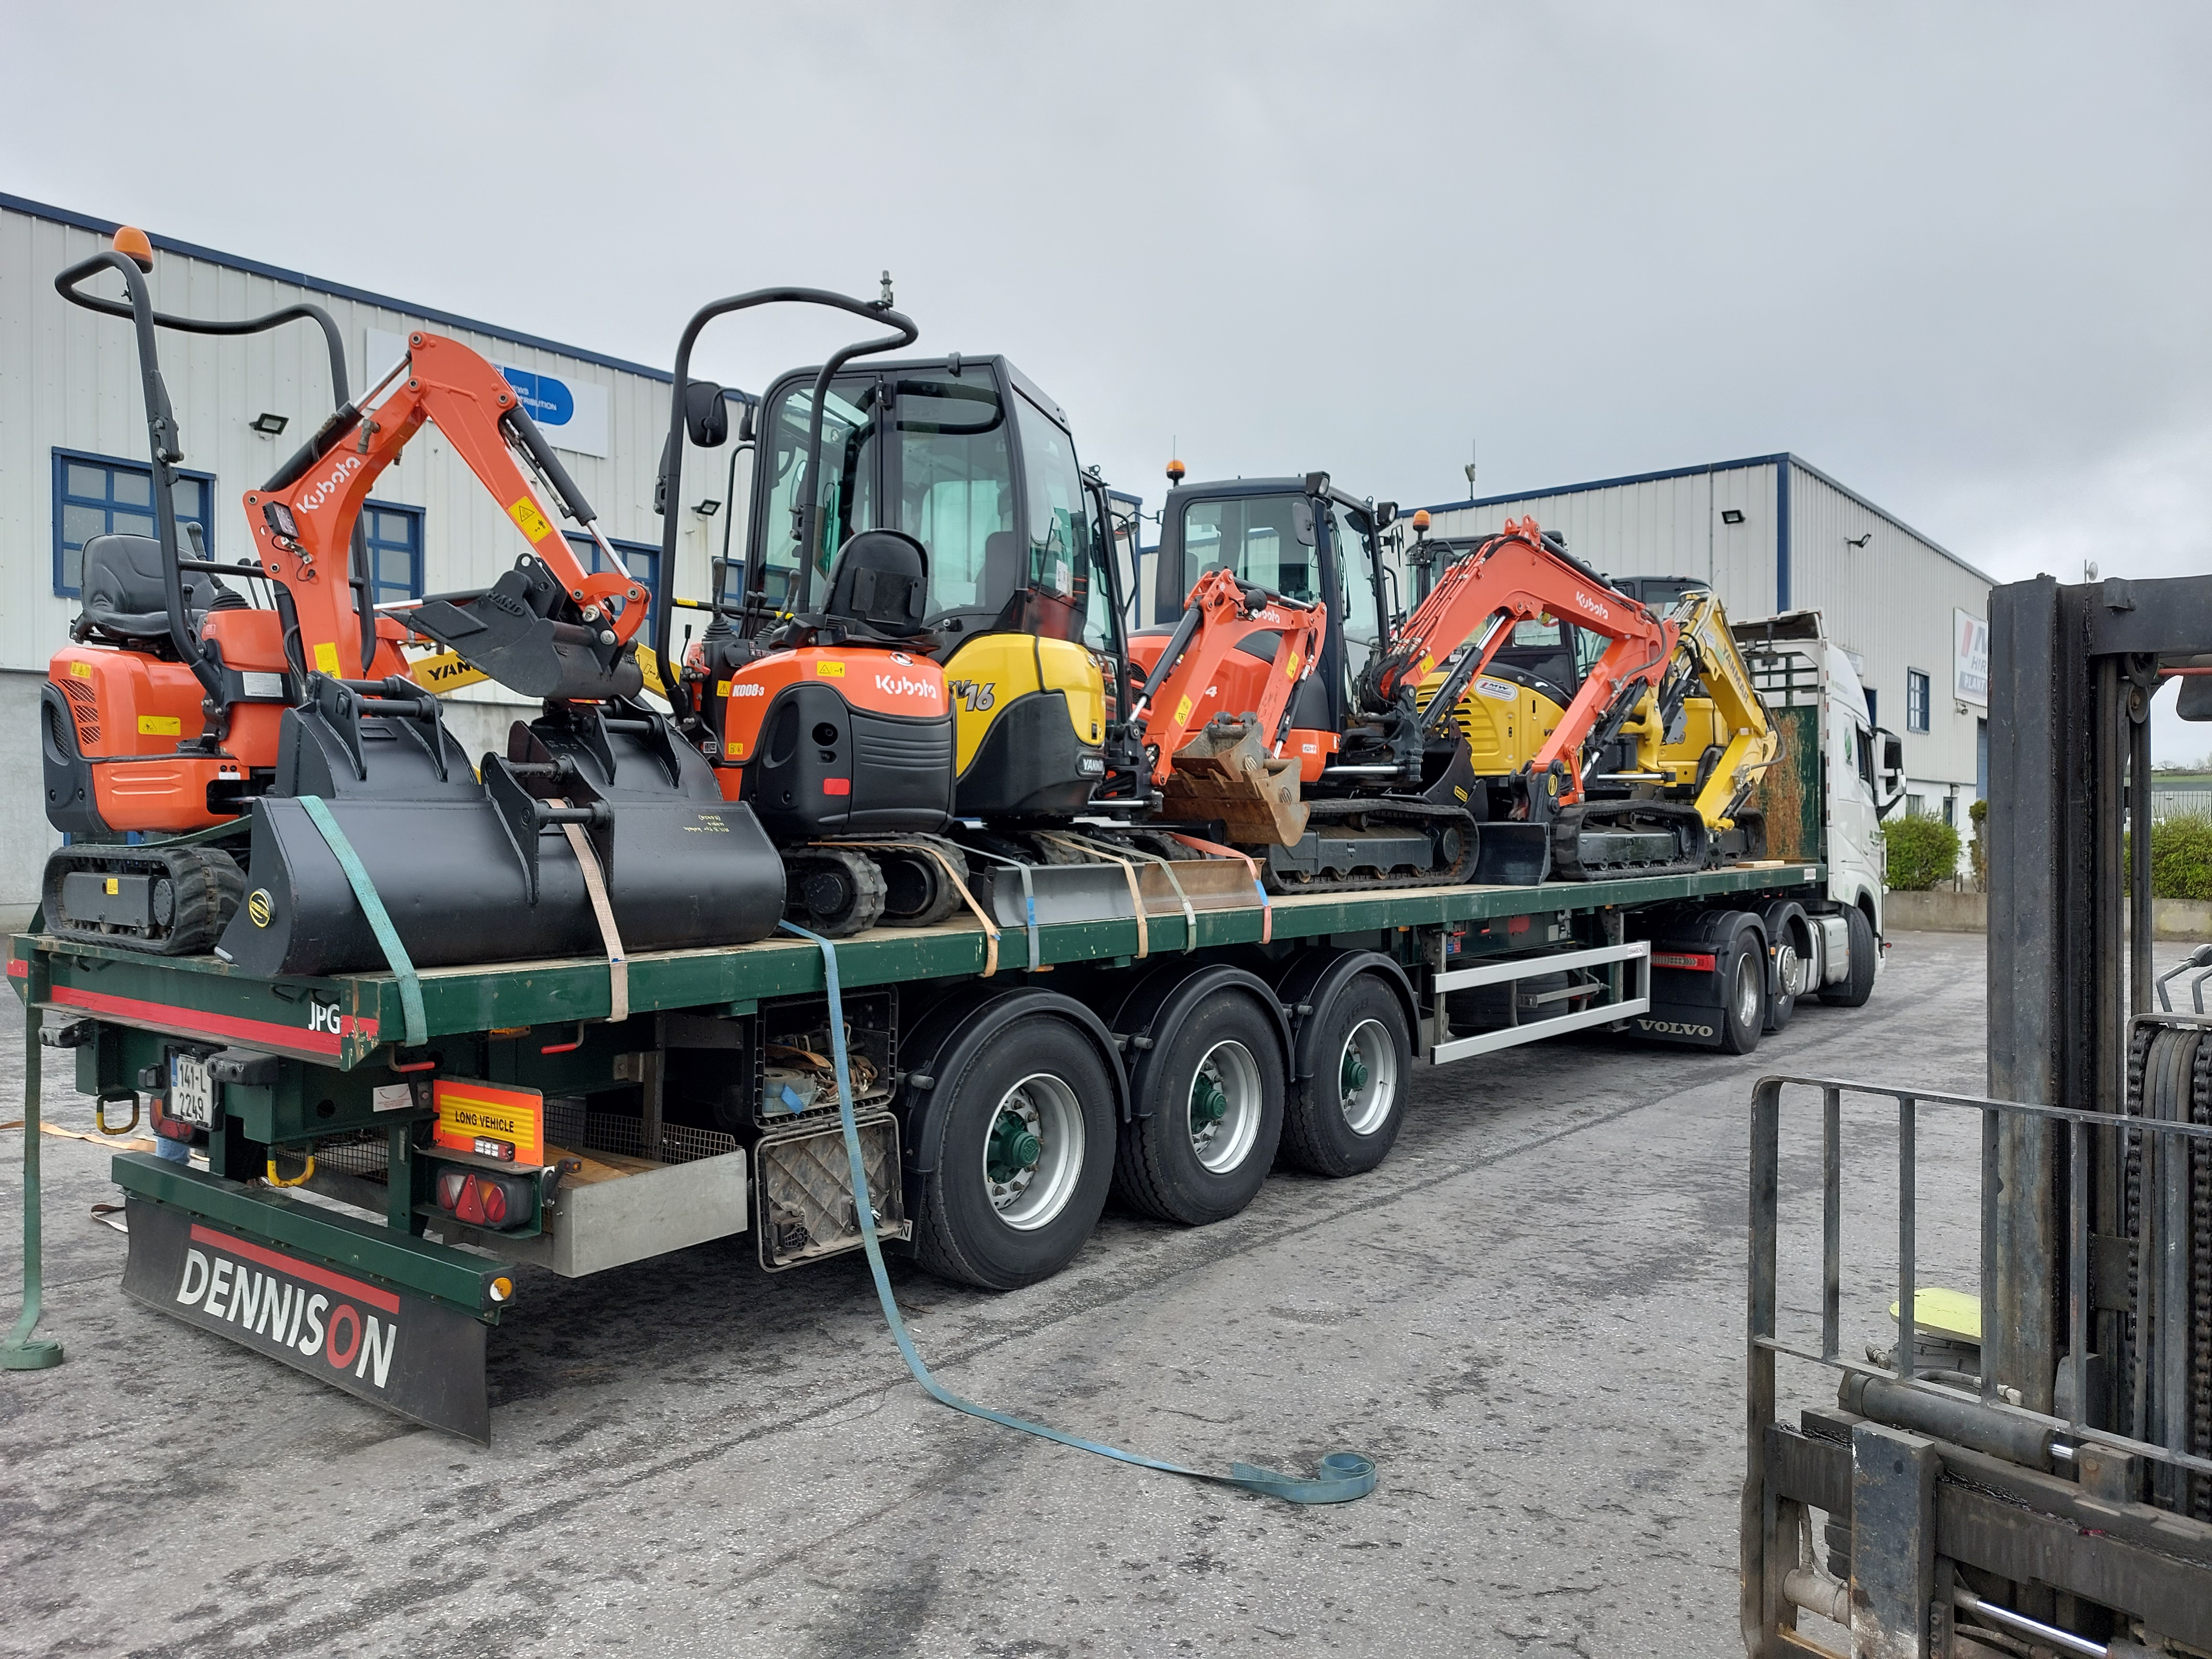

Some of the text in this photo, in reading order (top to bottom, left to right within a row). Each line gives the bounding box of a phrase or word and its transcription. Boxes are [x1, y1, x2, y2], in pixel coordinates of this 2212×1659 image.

[296, 456, 361, 514] Kubota
[1576, 591, 1609, 620] Kubota
[428, 662, 472, 681] YAN
[1723, 642, 1749, 704] YANMAR
[1964, 674, 1985, 692] PLANT
[732, 684, 765, 697] K008-3
[875, 675, 937, 699] Kubota
[308, 1001, 340, 1034] JPG
[1637, 1019, 1714, 1037] VOLVO
[180, 1063, 207, 1094] 141-L
[179, 1091, 204, 1120] 2249
[455, 1110, 514, 1133] LONG VEHICLE
[177, 1248, 397, 1388] DENNISON
